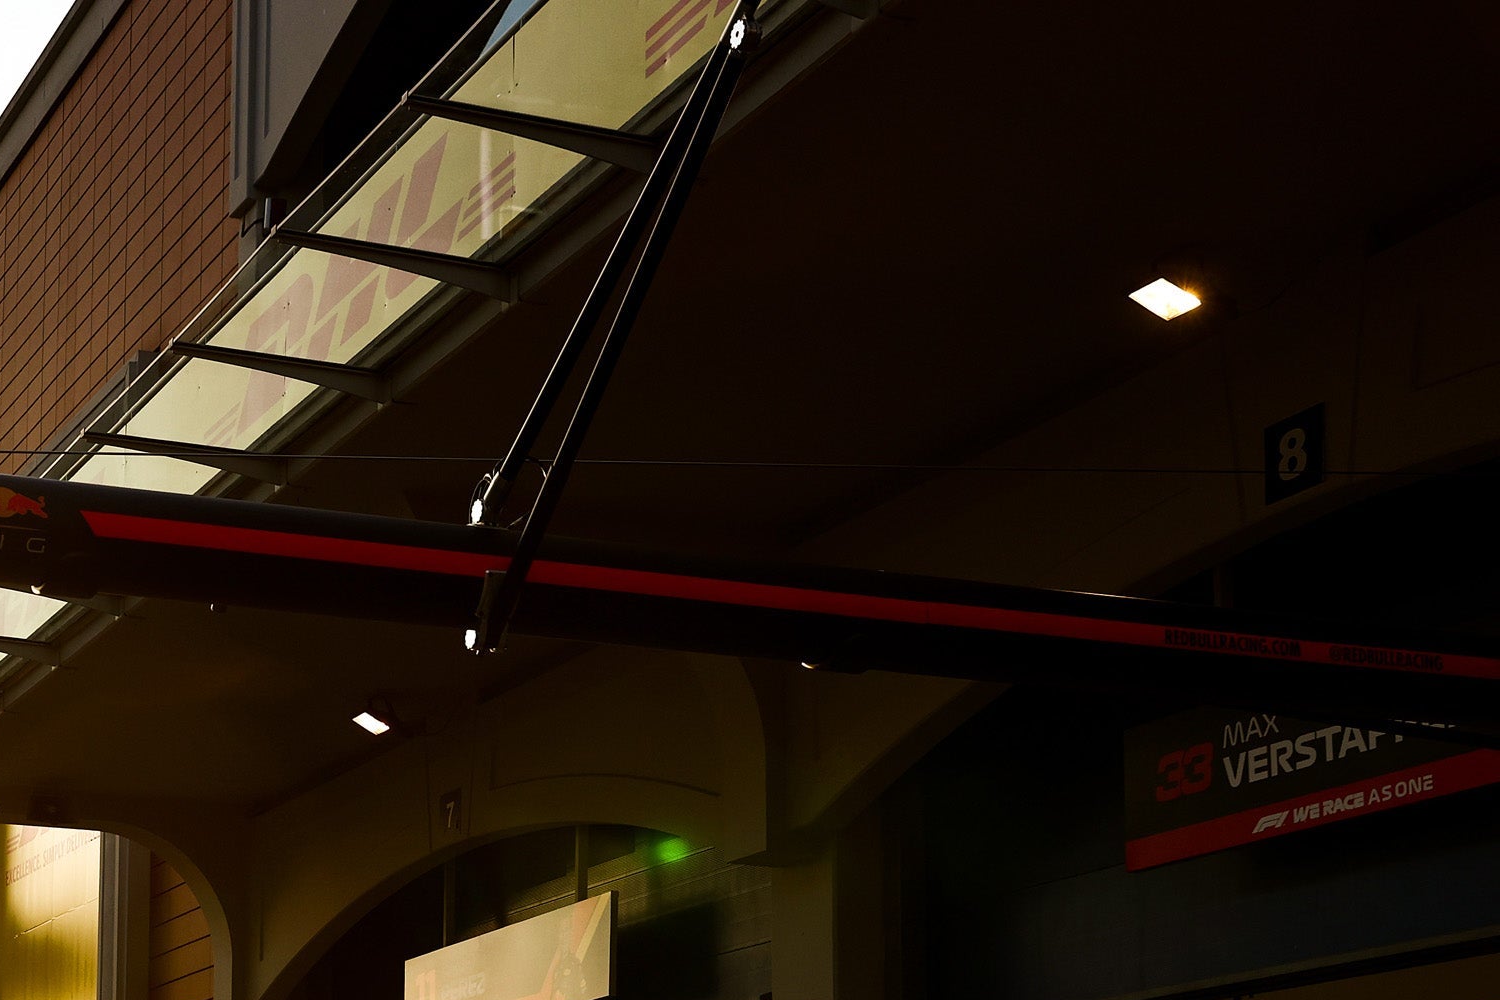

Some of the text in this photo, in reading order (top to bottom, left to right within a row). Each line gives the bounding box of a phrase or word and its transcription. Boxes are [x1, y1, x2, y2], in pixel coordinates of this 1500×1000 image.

[1278, 428, 1306, 480] 8
[1164, 628, 1444, 672] REDBULLRACING.COM @REDBULLRACING
[1222, 713, 1279, 748] MAX
[1155, 741, 1214, 801] 33
[1222, 725, 1404, 788] VERSTA
[1293, 803, 1320, 824] WE
[1323, 791, 1365, 817] RACE
[1368, 784, 1393, 806] AS
[1395, 774, 1434, 797] ONE
